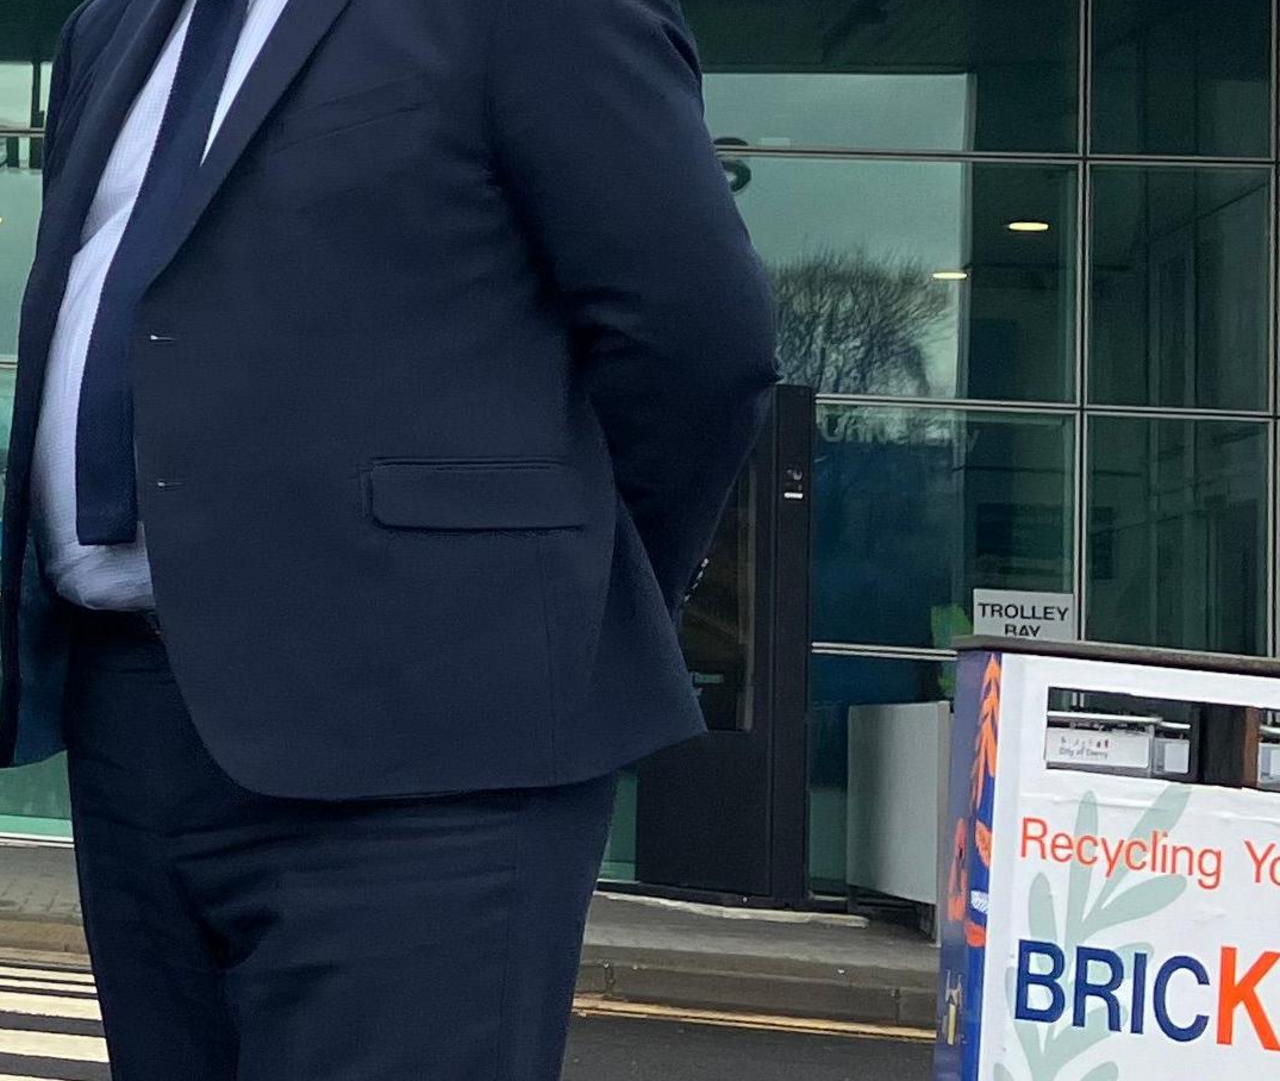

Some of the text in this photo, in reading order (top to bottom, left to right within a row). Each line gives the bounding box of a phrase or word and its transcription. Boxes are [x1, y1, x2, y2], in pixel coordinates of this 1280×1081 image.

[977, 603, 1069, 621] TROLLEY
[1004, 624, 1041, 637] BAY
[1020, 816, 1222, 890] Recycling
[1015, 938, 1280, 1052] BRICK
